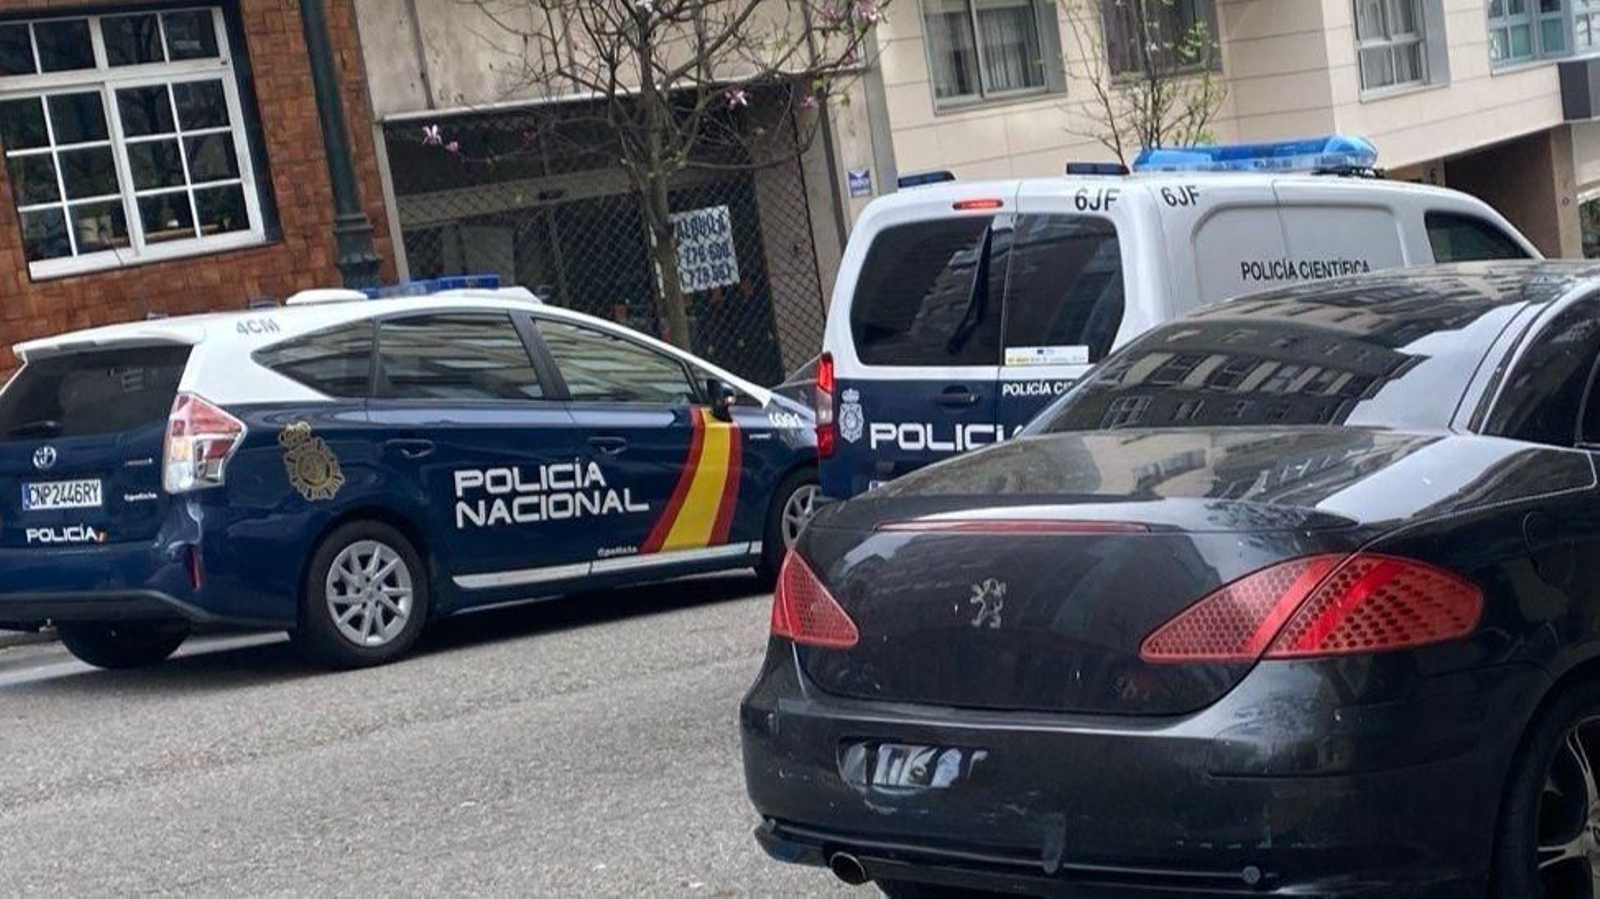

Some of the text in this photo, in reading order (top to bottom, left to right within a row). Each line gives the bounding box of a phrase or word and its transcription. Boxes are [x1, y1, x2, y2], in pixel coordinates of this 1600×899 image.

[1074, 187, 1121, 211] 6JF
[1162, 185, 1201, 207] 6JF
[1241, 258, 1298, 281] POLICÍA
[236, 320, 280, 335] 4CM
[1002, 380, 1052, 396] POLICÍA
[454, 458, 606, 497] POLICÍA
[30, 480, 99, 505] CNP2446RY
[455, 490, 650, 529] NACIONAL
[26, 524, 96, 543] POLICÍA
